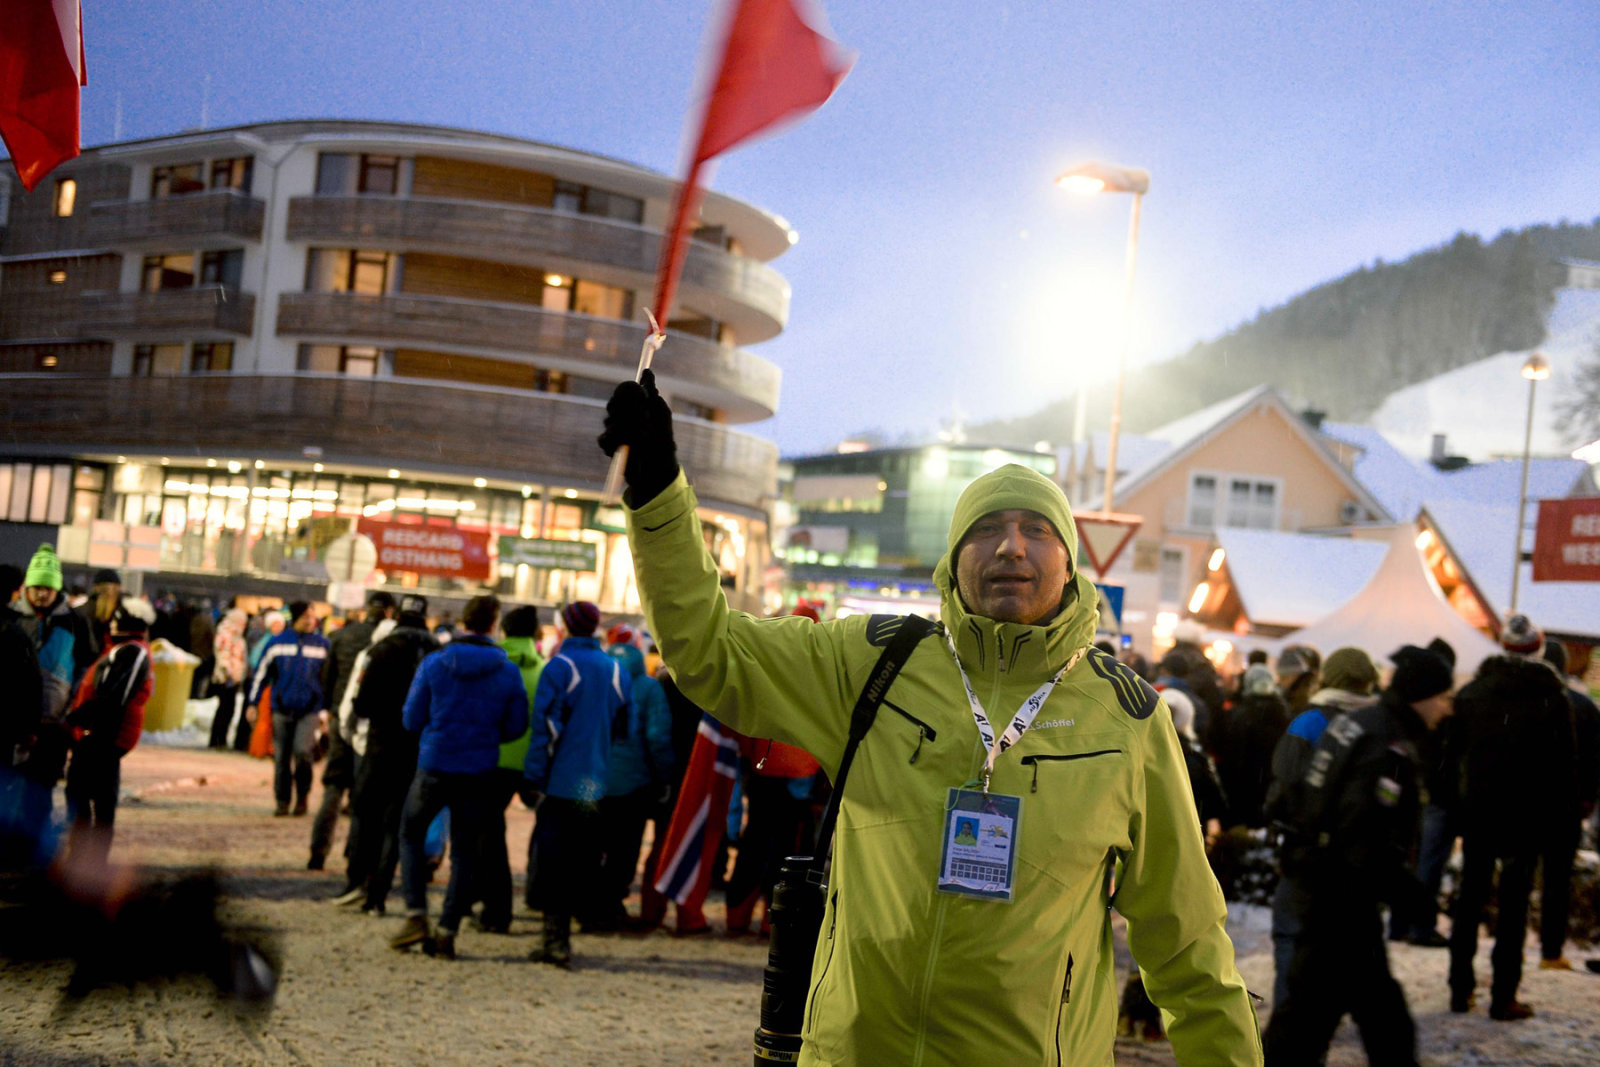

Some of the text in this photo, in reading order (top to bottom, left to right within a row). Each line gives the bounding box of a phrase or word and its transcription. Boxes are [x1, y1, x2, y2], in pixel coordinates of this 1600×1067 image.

[381, 547, 462, 570] OSTHANG
[867, 660, 896, 702] Nikon
[974, 711, 990, 726] A1
[1013, 716, 1026, 735] A1
[1035, 718, 1075, 729] Schöffel
[981, 731, 994, 748] A1
[1000, 734, 1011, 752] A1
